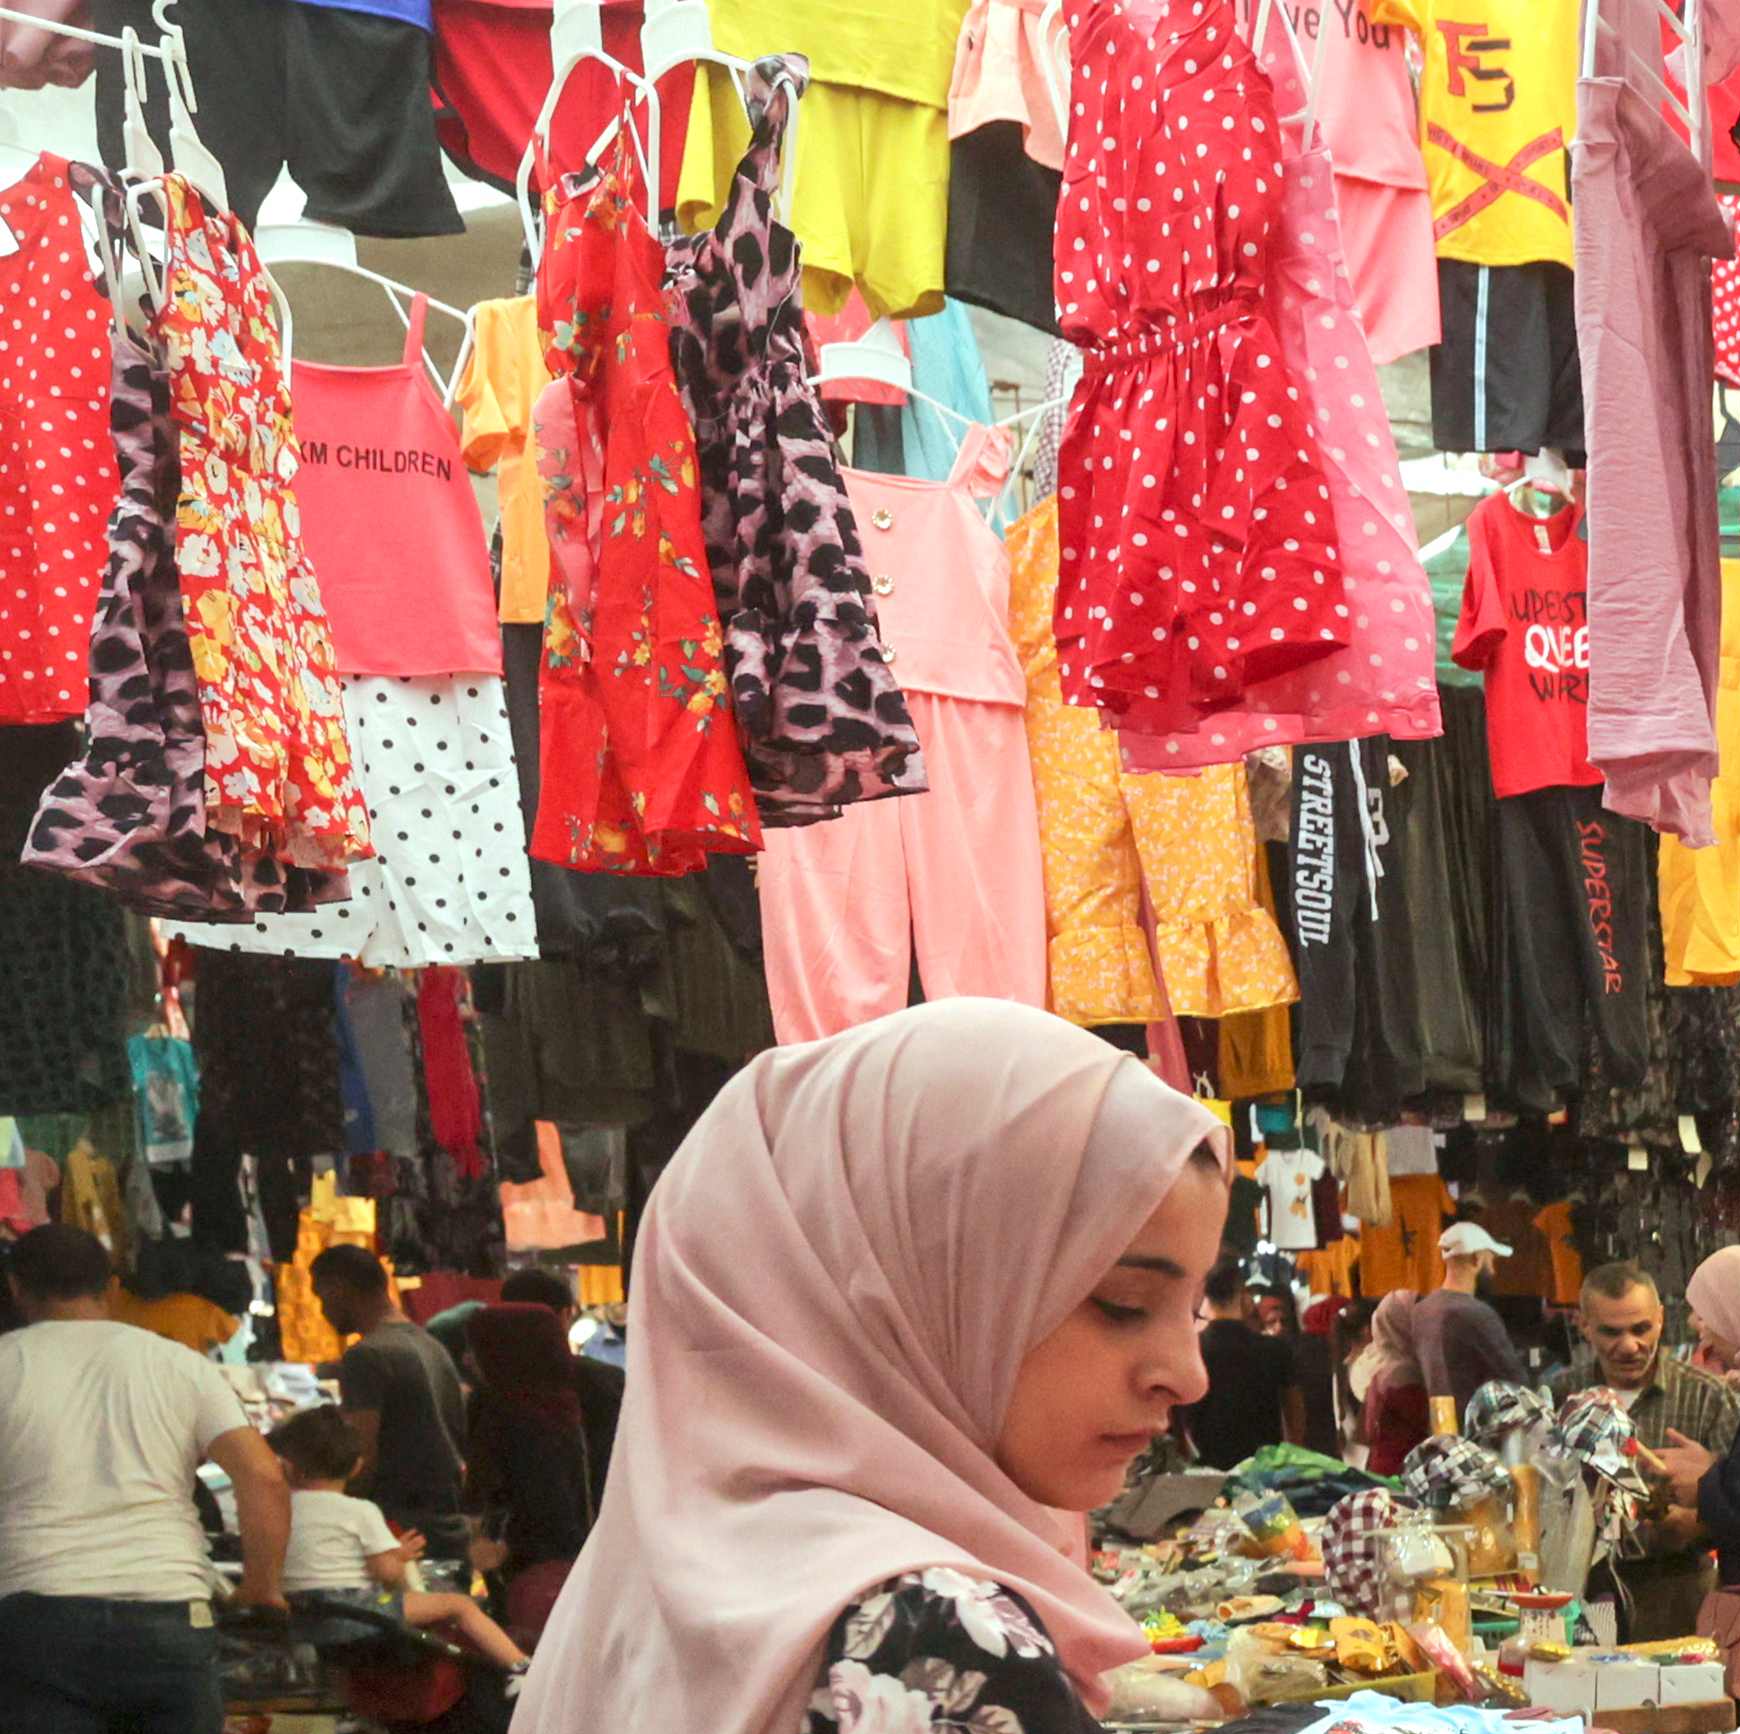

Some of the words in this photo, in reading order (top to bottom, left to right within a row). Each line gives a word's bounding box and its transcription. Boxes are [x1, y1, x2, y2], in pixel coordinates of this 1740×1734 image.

[336, 444, 452, 482] CHILDREN
[1295, 752, 1336, 949] STREETSOUL
[1576, 819, 1624, 995] SUPERSTAR
